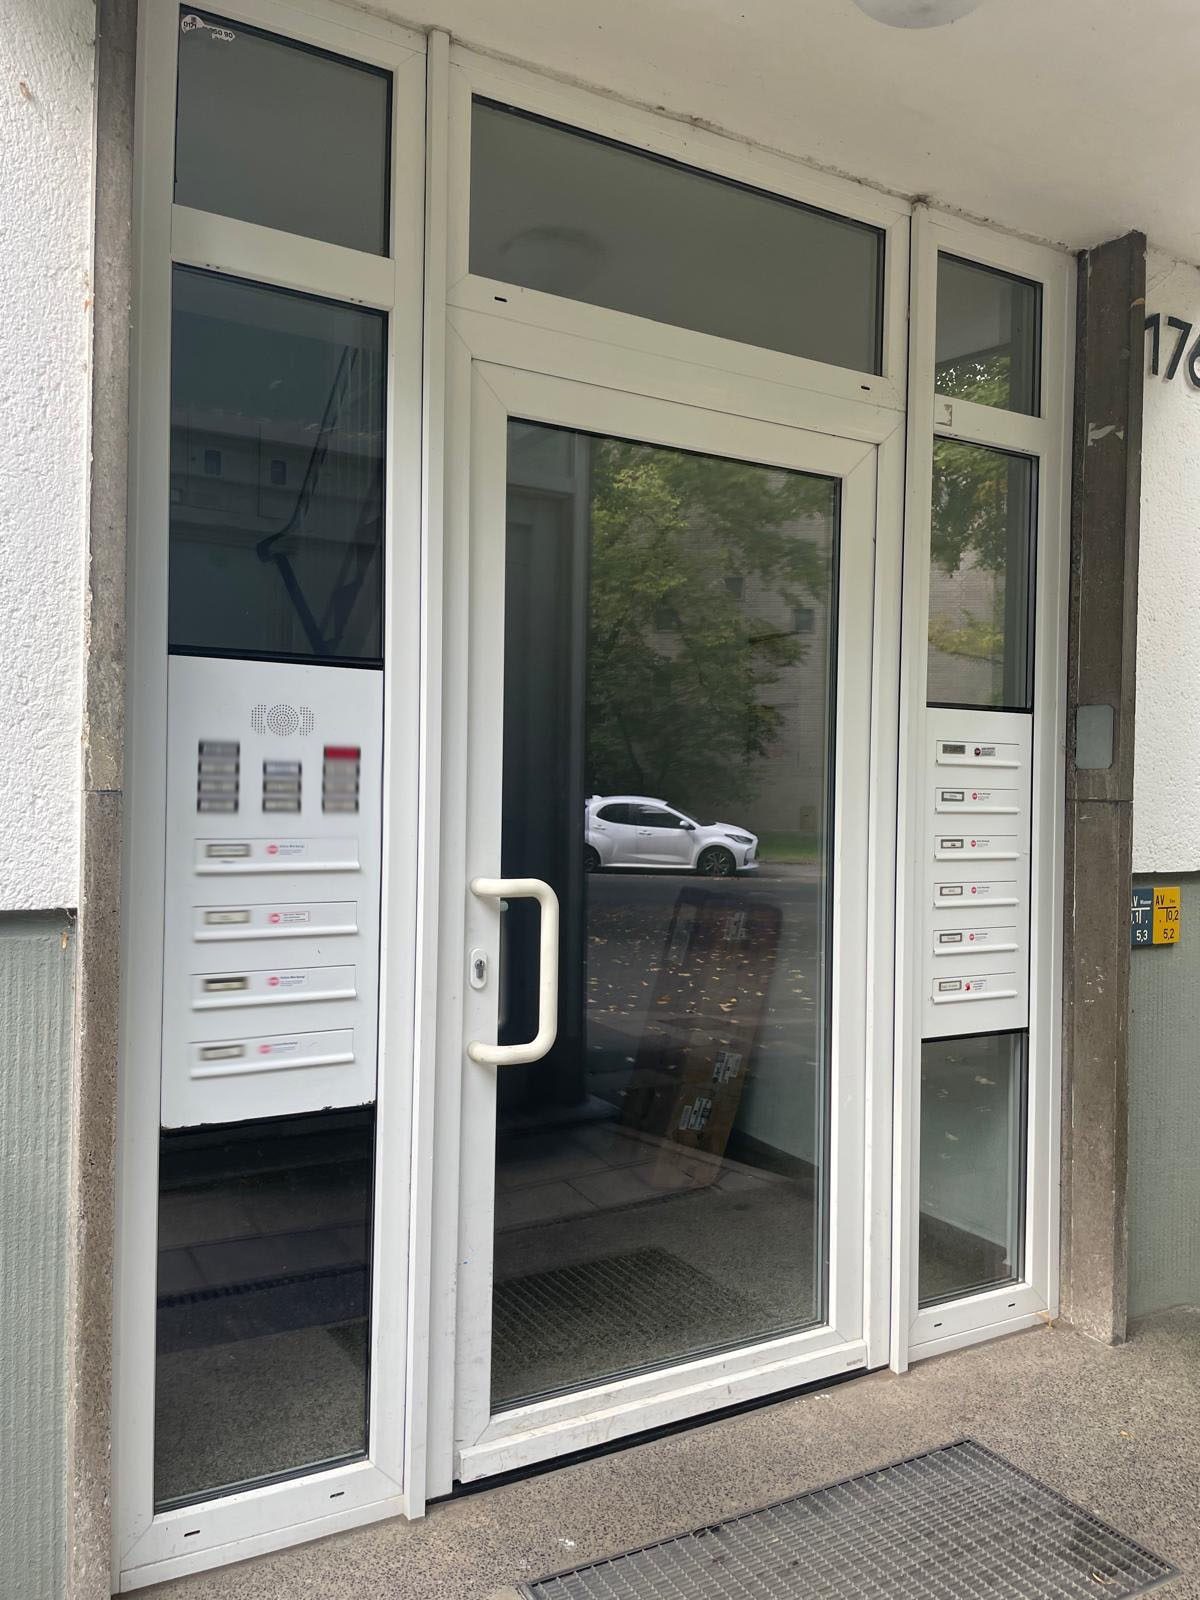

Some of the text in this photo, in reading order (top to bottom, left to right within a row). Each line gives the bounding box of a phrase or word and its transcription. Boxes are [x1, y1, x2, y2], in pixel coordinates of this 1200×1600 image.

[1155, 895, 1165, 906] AV
[1136, 929, 1148, 942] 5,3
[1163, 928, 1175, 940] 5,2
